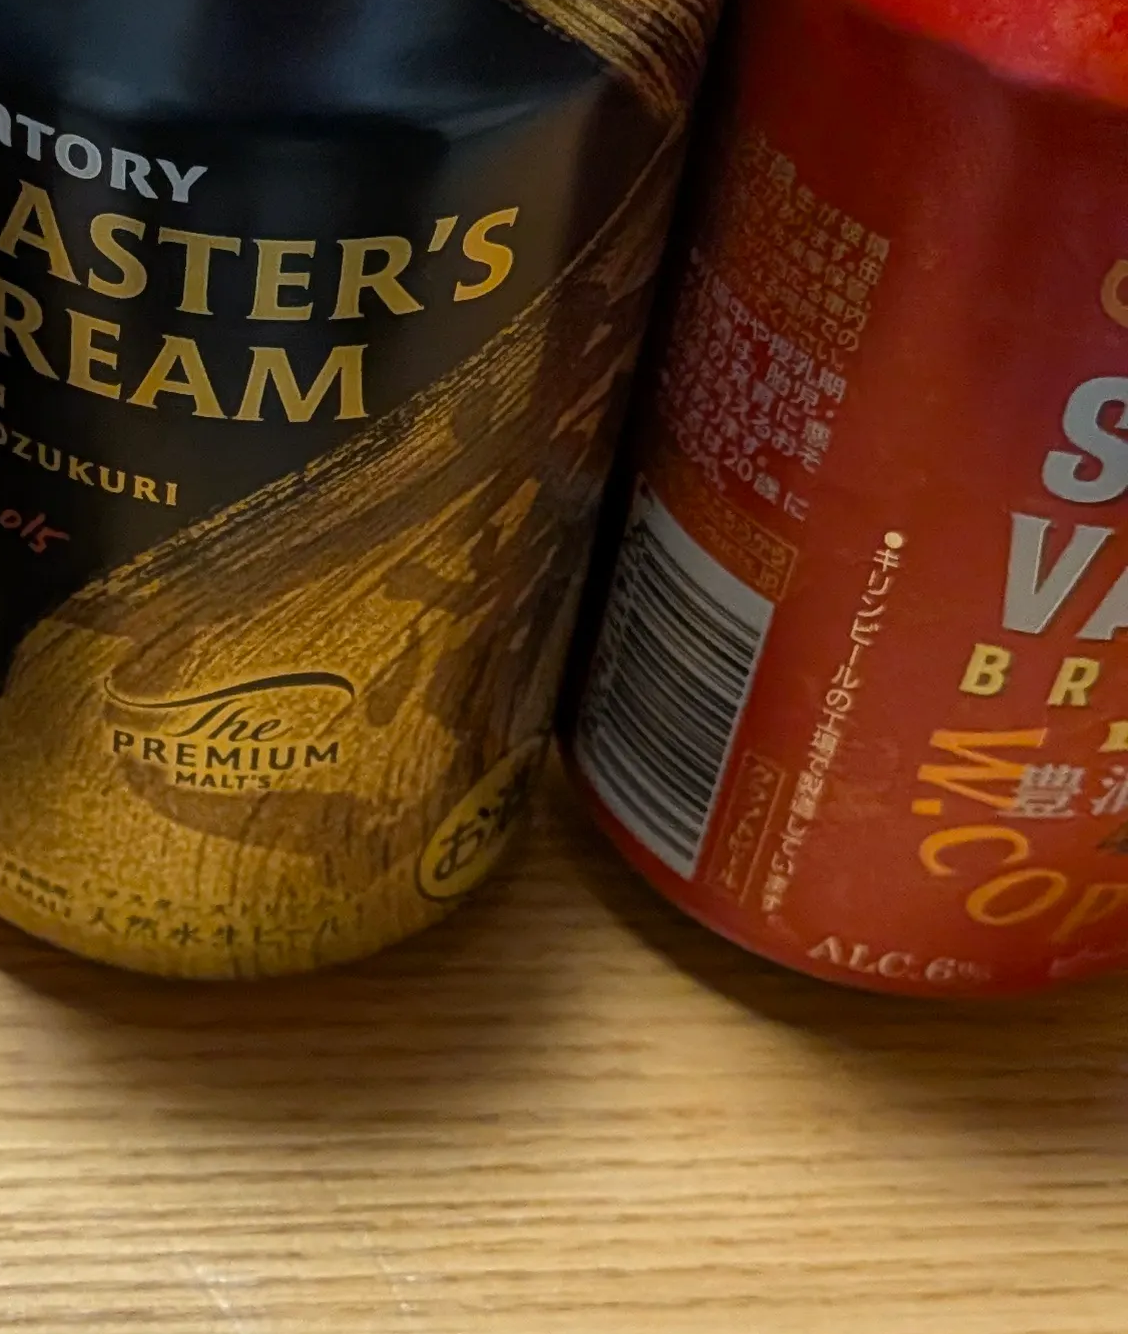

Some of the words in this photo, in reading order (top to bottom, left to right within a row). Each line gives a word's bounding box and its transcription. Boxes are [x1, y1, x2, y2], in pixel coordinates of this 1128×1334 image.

[165, 697, 294, 742] The
[112, 729, 340, 771] PREMIUM
[175, 770, 272, 790] MALT'S
